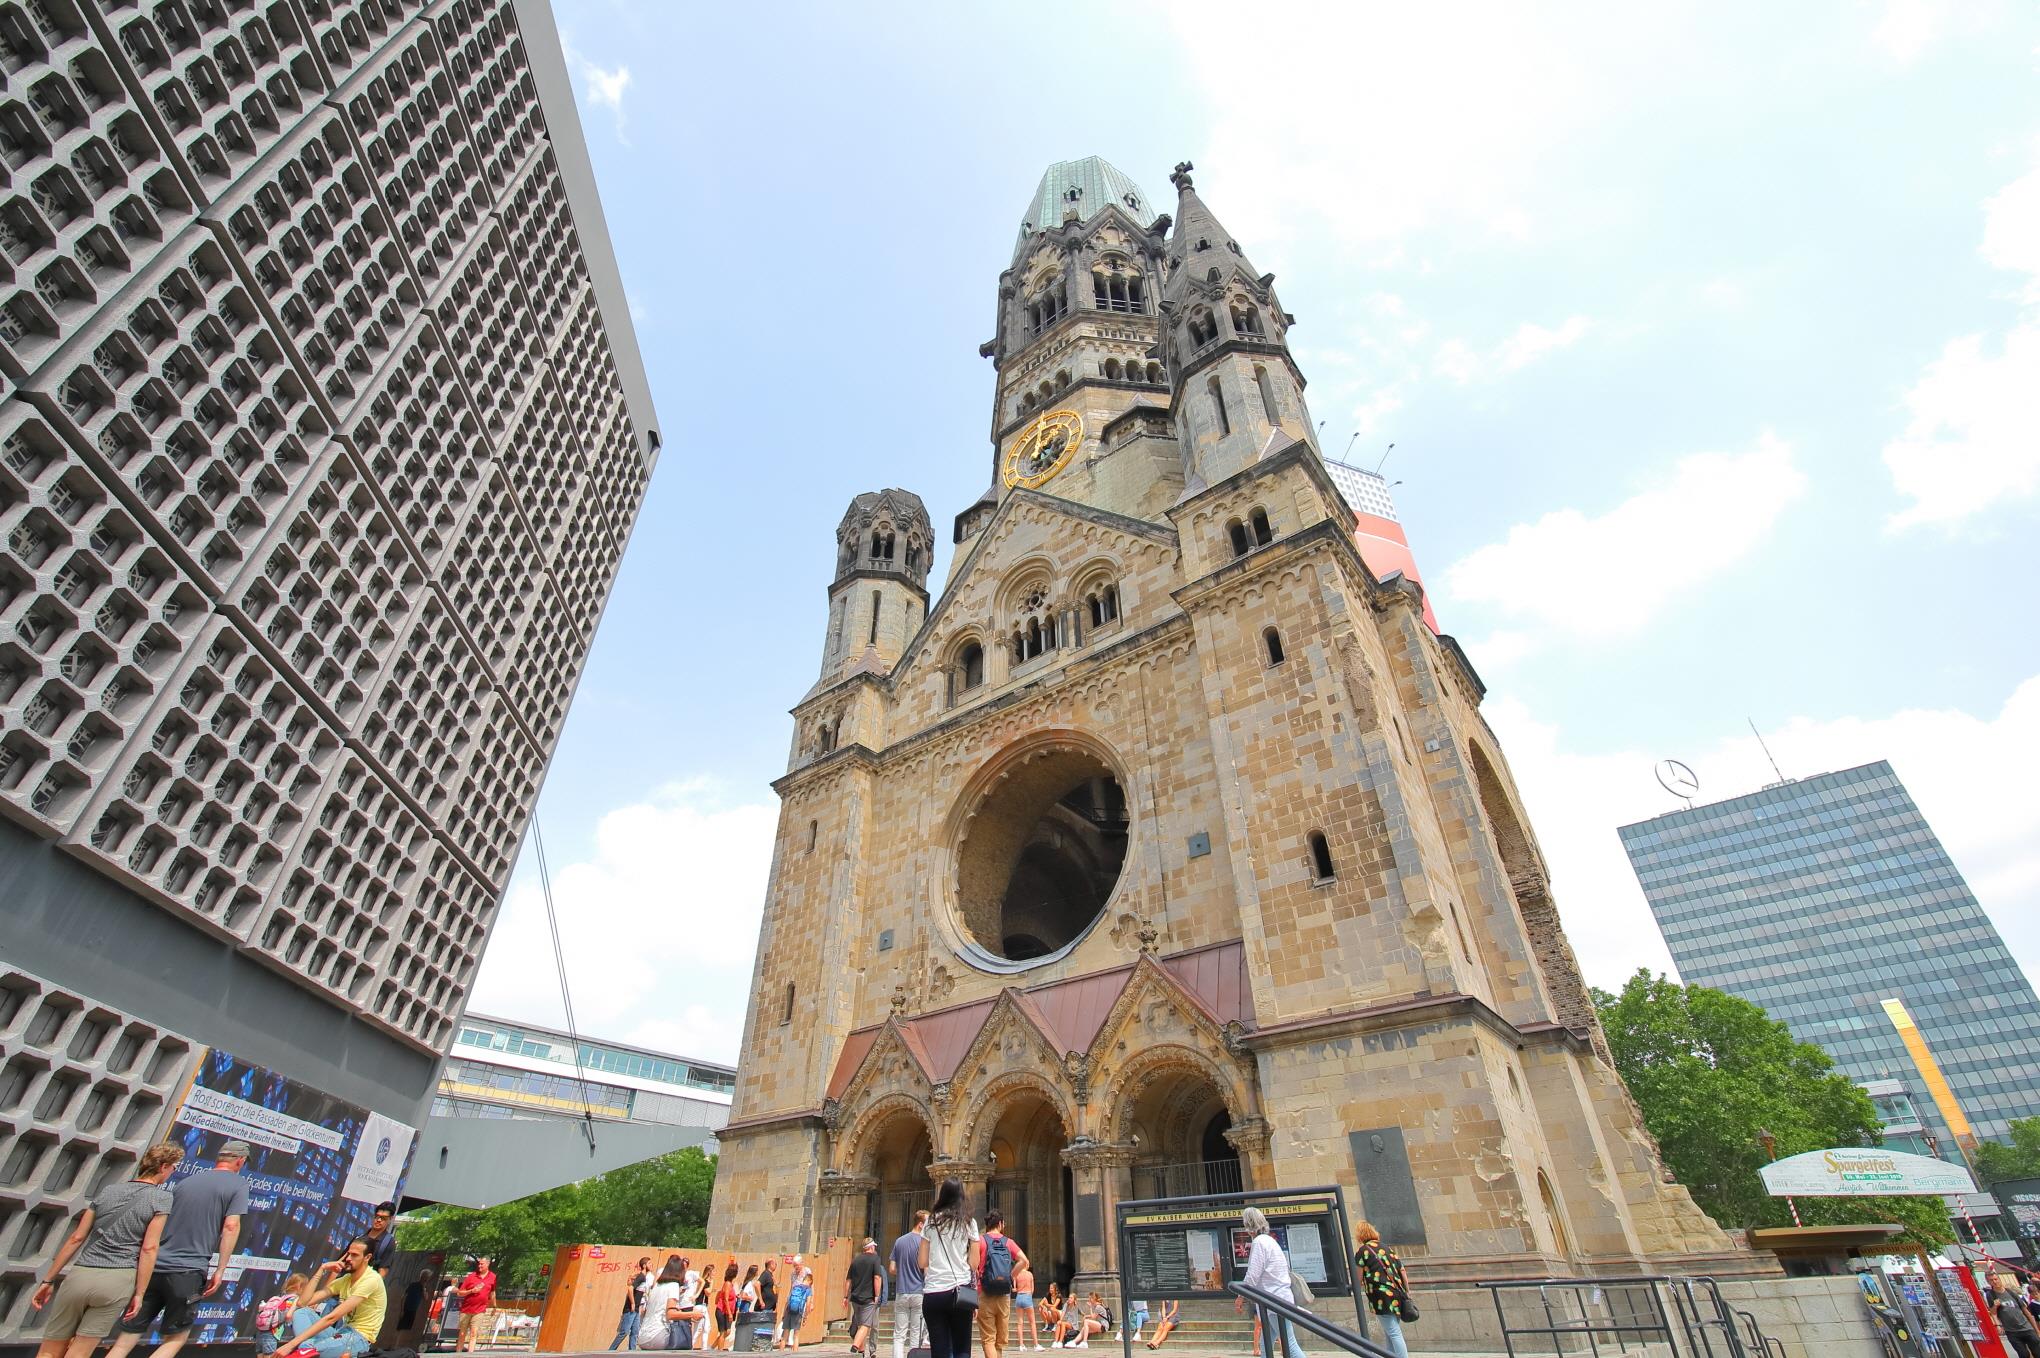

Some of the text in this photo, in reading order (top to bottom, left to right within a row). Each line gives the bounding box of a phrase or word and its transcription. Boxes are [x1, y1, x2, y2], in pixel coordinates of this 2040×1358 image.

[193, 1089, 212, 1107] Rost
[211, 1097, 244, 1118] sprengt
[243, 1107, 256, 1120] die
[256, 1110, 288, 1131] Fassaden
[287, 1122, 298, 1133] am
[249, 1131, 271, 1144] braucht
[1824, 1151, 1897, 1180] Spargelfest
[182, 1160, 192, 1174] is
[273, 1180, 286, 1192] of
[282, 1183, 293, 1196] the
[292, 1184, 307, 1197] bell
[306, 1187, 325, 1201] tower
[253, 1197, 272, 1210] help!
